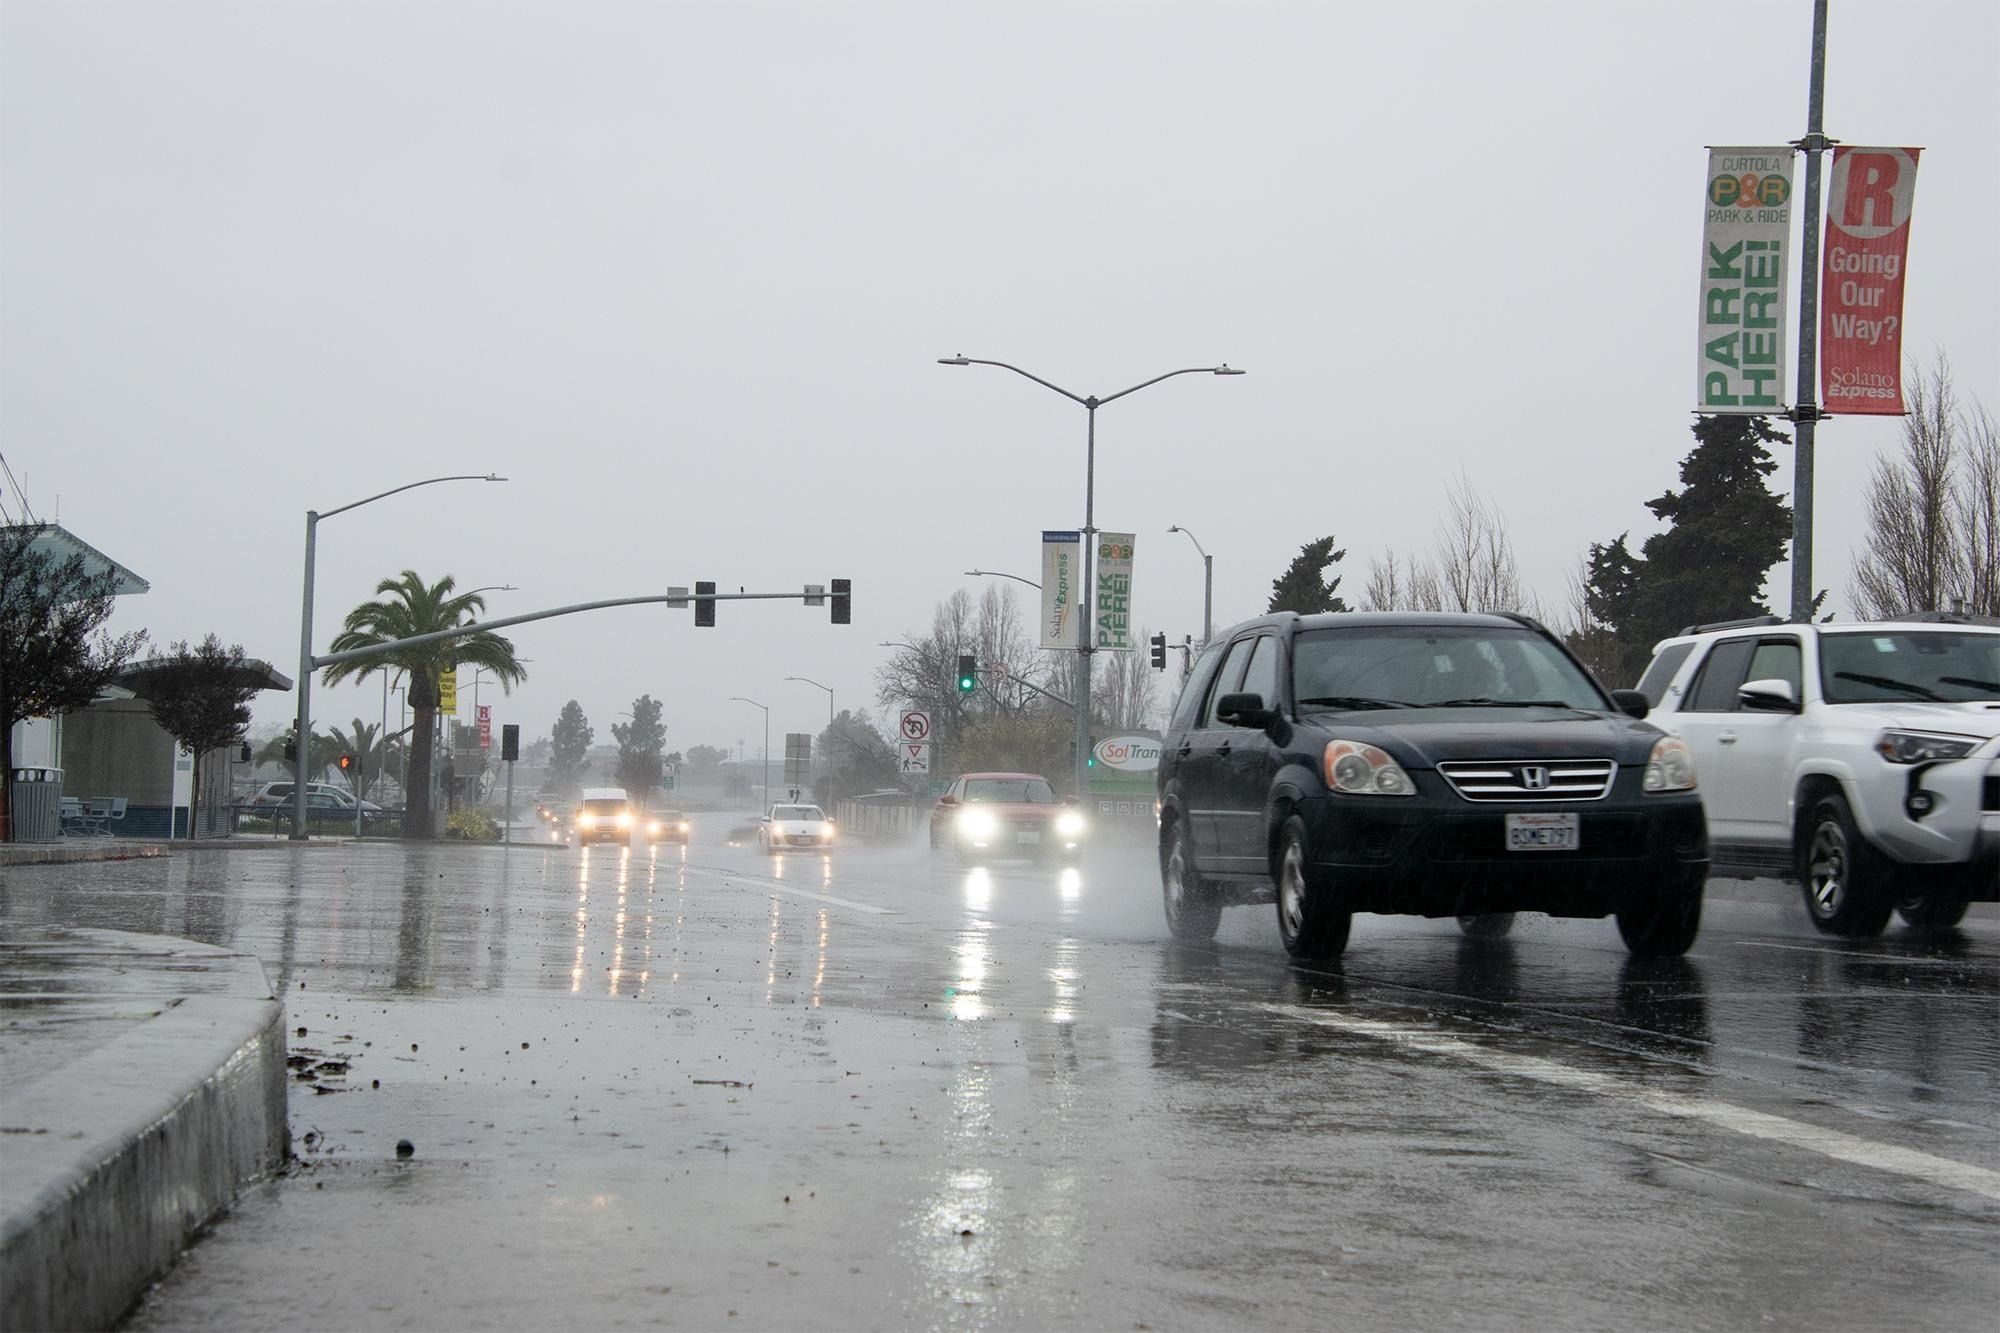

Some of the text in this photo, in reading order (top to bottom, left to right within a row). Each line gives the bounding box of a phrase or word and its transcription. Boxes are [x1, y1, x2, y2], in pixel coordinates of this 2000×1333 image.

[1722, 157, 1781, 171] CURTOLA
[1842, 153, 1900, 227] R
[1708, 210, 1788, 223] PARK & RIDE
[1829, 246, 1900, 280] Going
[1840, 280, 1884, 307] Our
[1705, 240, 1743, 406] PARK
[1742, 240, 1781, 406] HERE!
[1831, 313, 1898, 345] Way?
[1828, 384, 1896, 399] Express
[1830, 367, 1894, 387] Solano
[1058, 553, 1069, 605] Express
[1098, 572, 1114, 648] PARK
[1112, 573, 1129, 648] HERE!
[1105, 744, 1160, 759] SolTran
